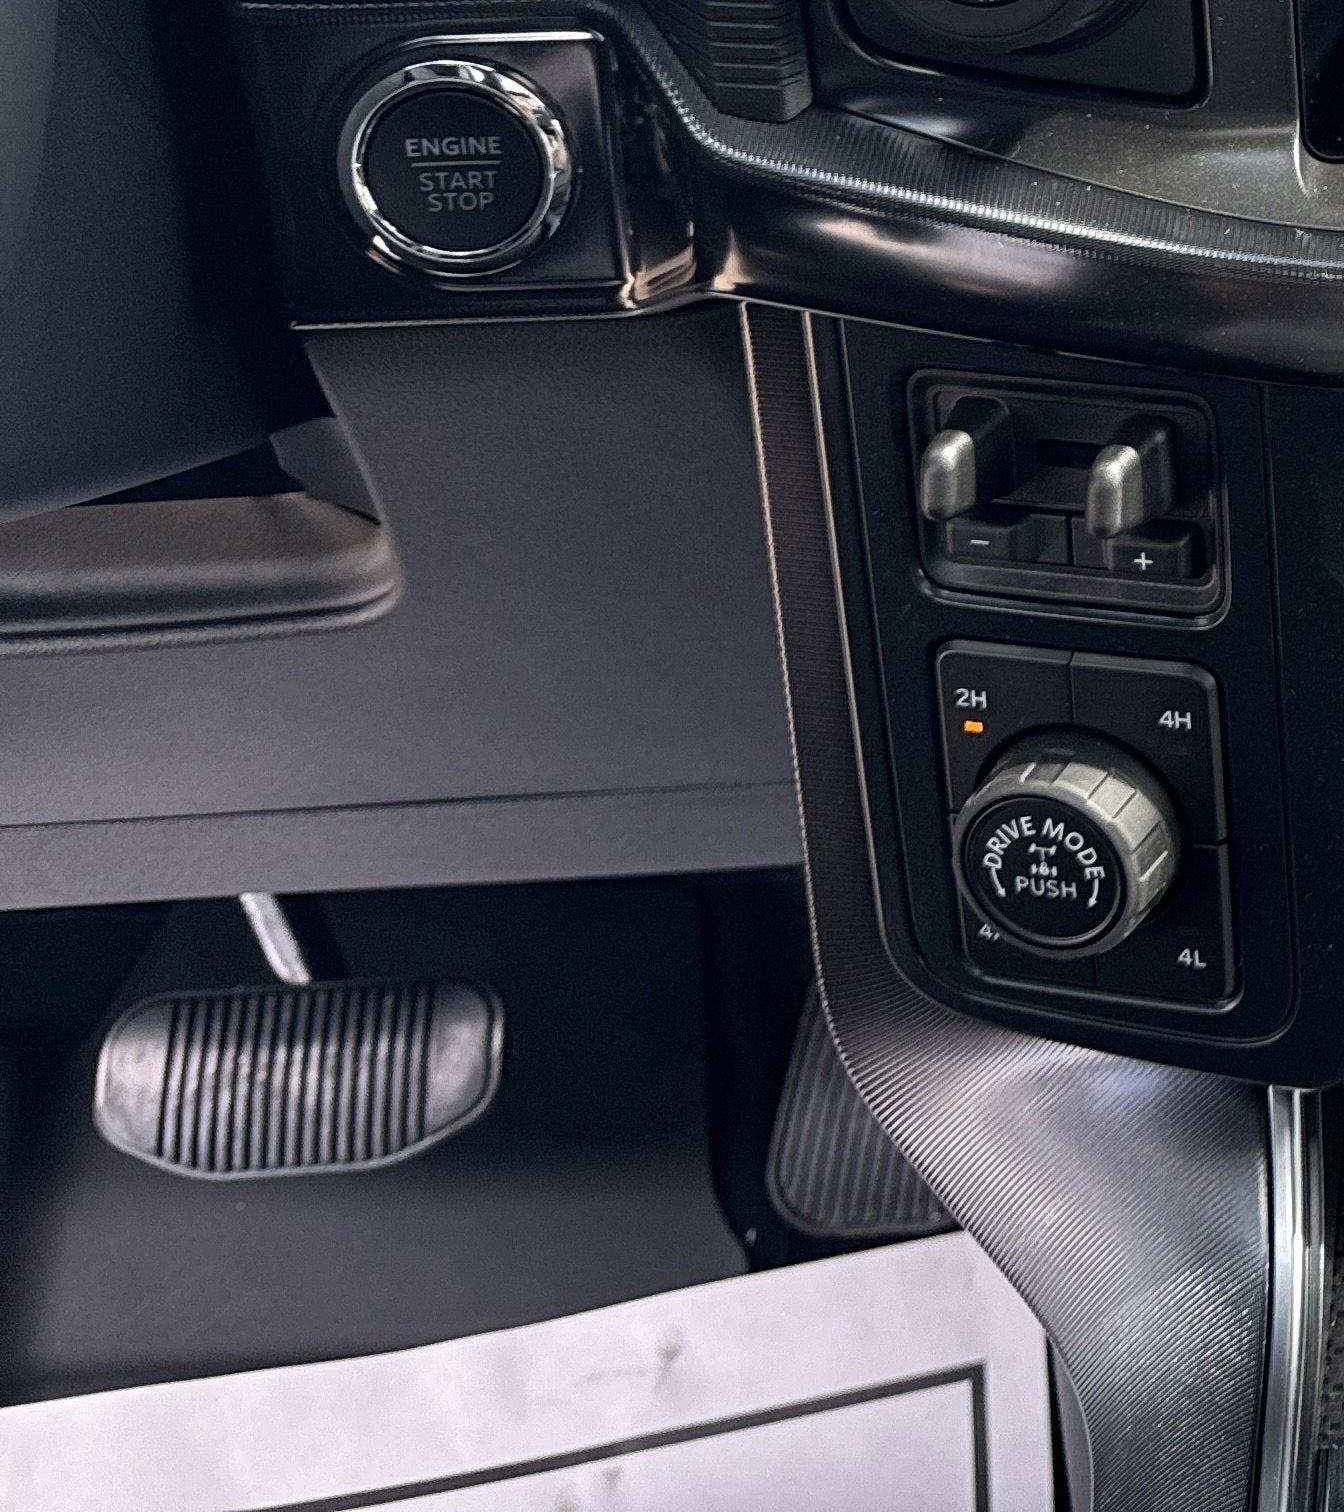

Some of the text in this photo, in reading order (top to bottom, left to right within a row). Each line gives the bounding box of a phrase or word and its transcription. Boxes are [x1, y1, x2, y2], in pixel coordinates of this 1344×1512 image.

[404, 136, 503, 158] ENGINE
[418, 170, 498, 192] START
[427, 191, 495, 213] STOP
[955, 688, 988, 710] 2H
[1158, 710, 1193, 731] 4H
[982, 815, 1106, 880] DRIVE MODE
[1013, 875, 1078, 900] PUSH
[1177, 948, 1207, 968] 4L
